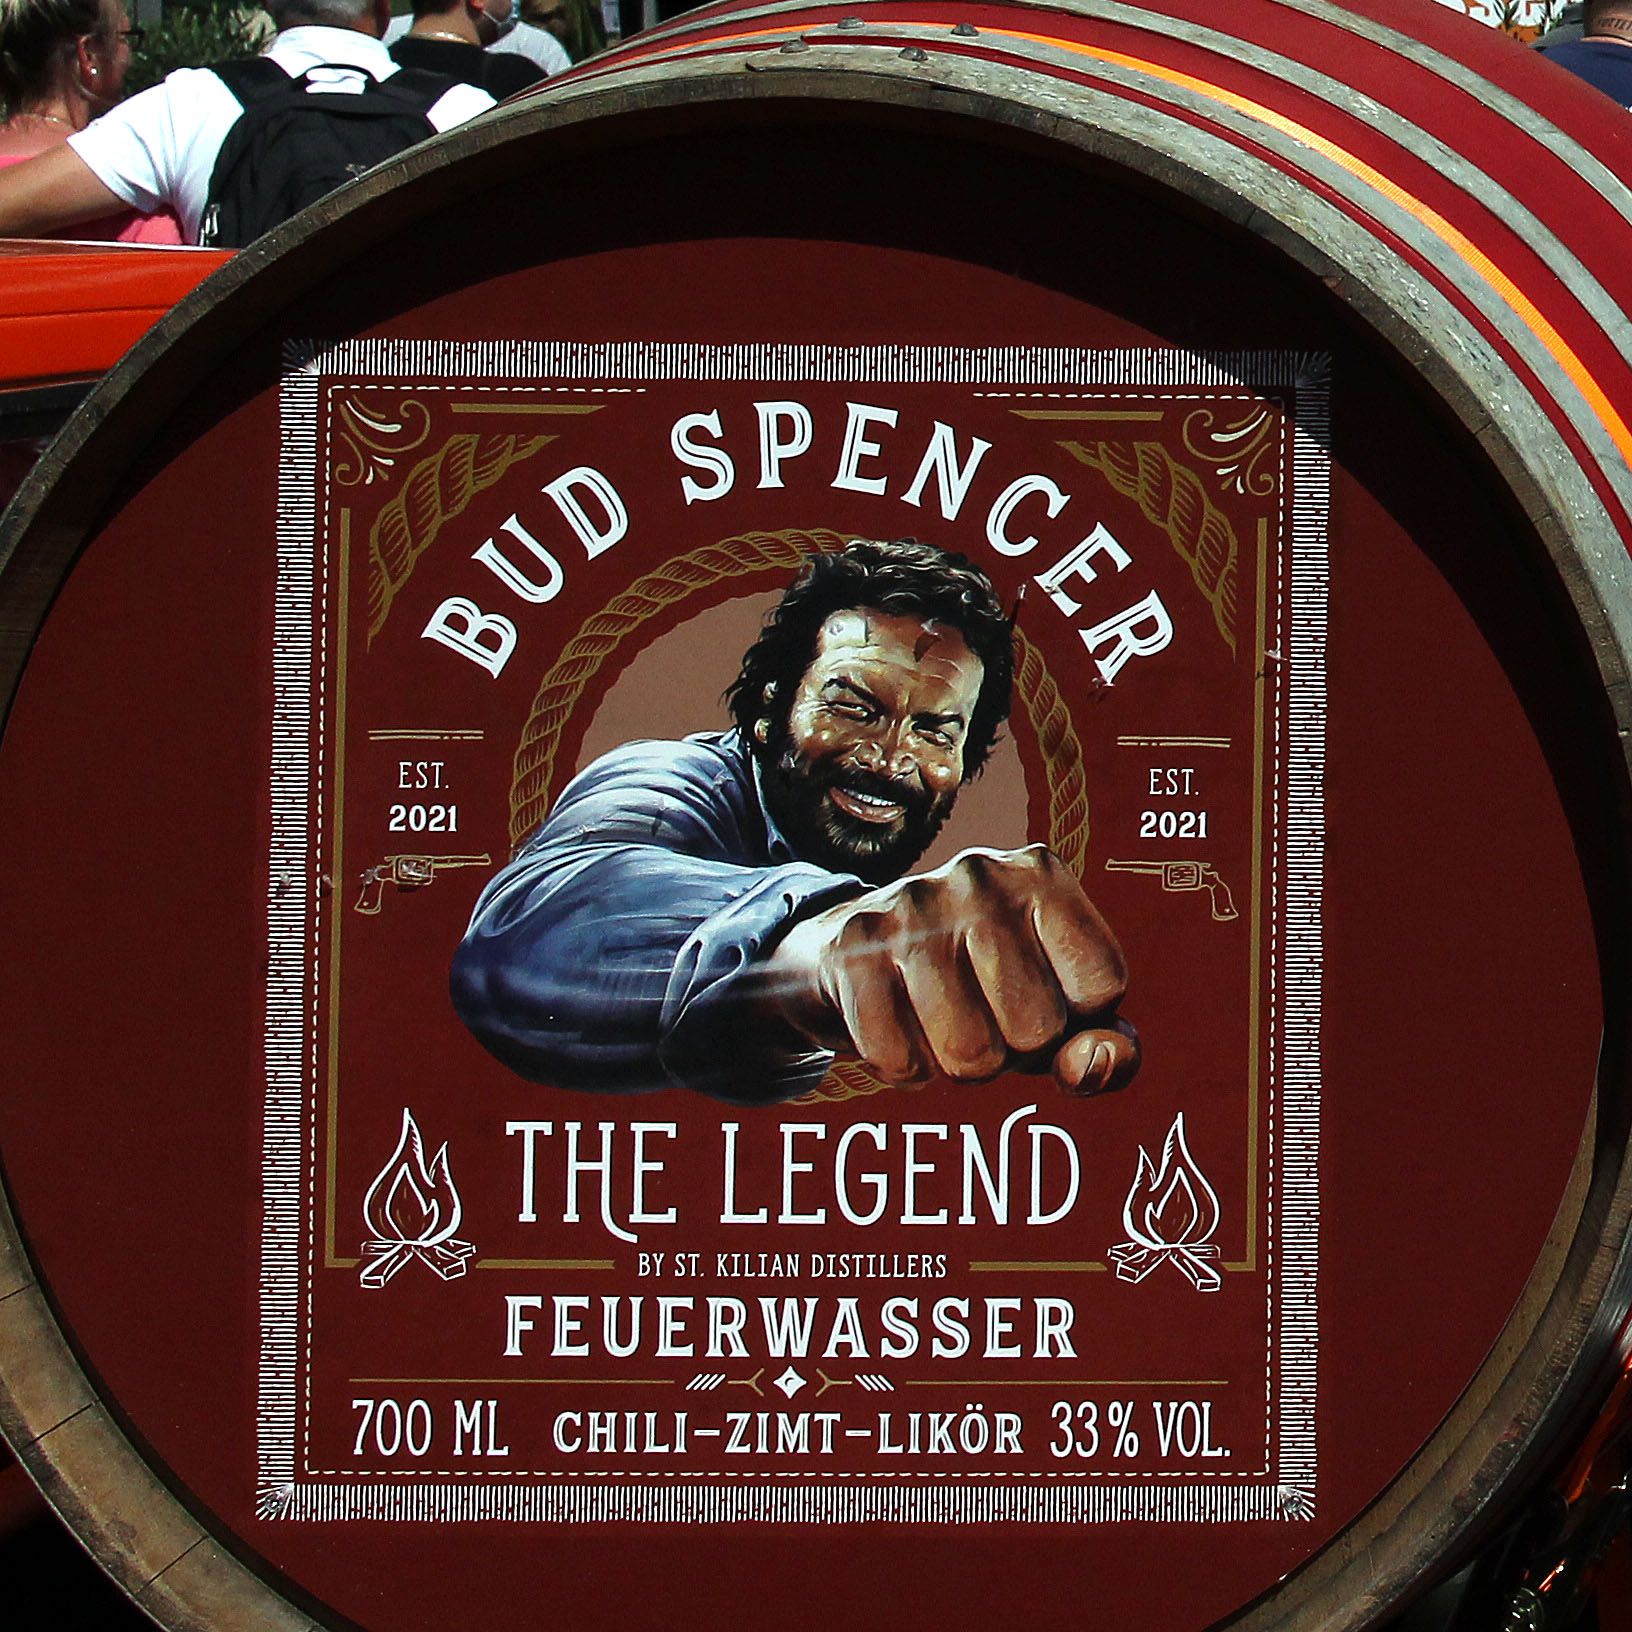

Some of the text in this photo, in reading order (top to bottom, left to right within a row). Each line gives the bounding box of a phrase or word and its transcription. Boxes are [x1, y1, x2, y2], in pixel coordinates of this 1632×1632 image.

[421, 400, 1175, 688] BUD SPENCER
[398, 761, 451, 790] EST.
[1149, 768, 1199, 796] EST.
[388, 804, 457, 832] 2021
[1139, 810, 1207, 838] 2021
[506, 1104, 1080, 1243] THE LEGEND
[638, 1252, 947, 1278] BY ST. KILIAN DISTILLERS
[503, 1295, 1078, 1359] FEUERWASSER
[352, 1399, 509, 1457] 700 ML
[1050, 1401, 1139, 1458] 33%
[1152, 1401, 1231, 1458] VOL.
